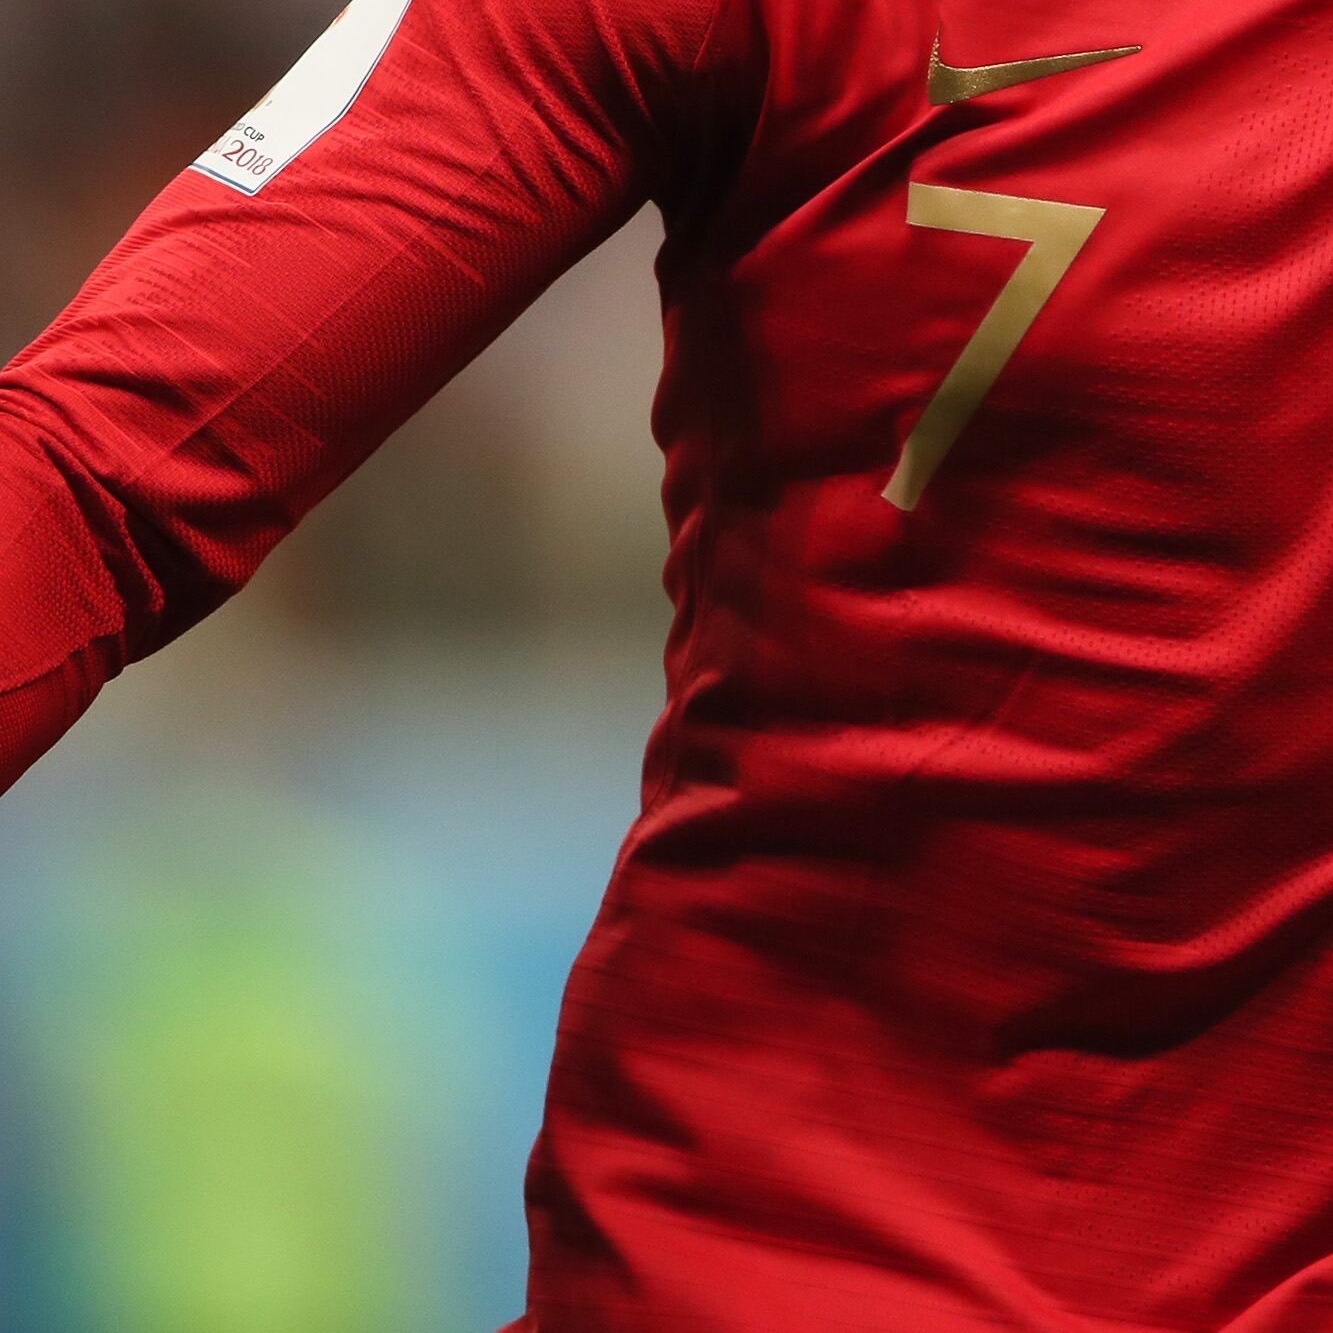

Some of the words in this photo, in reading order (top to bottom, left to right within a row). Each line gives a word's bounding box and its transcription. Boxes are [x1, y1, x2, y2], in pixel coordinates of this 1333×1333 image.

[244, 126, 265, 142] CUP
[222, 139, 273, 175] 2018
[881, 181, 1107, 512] 7
